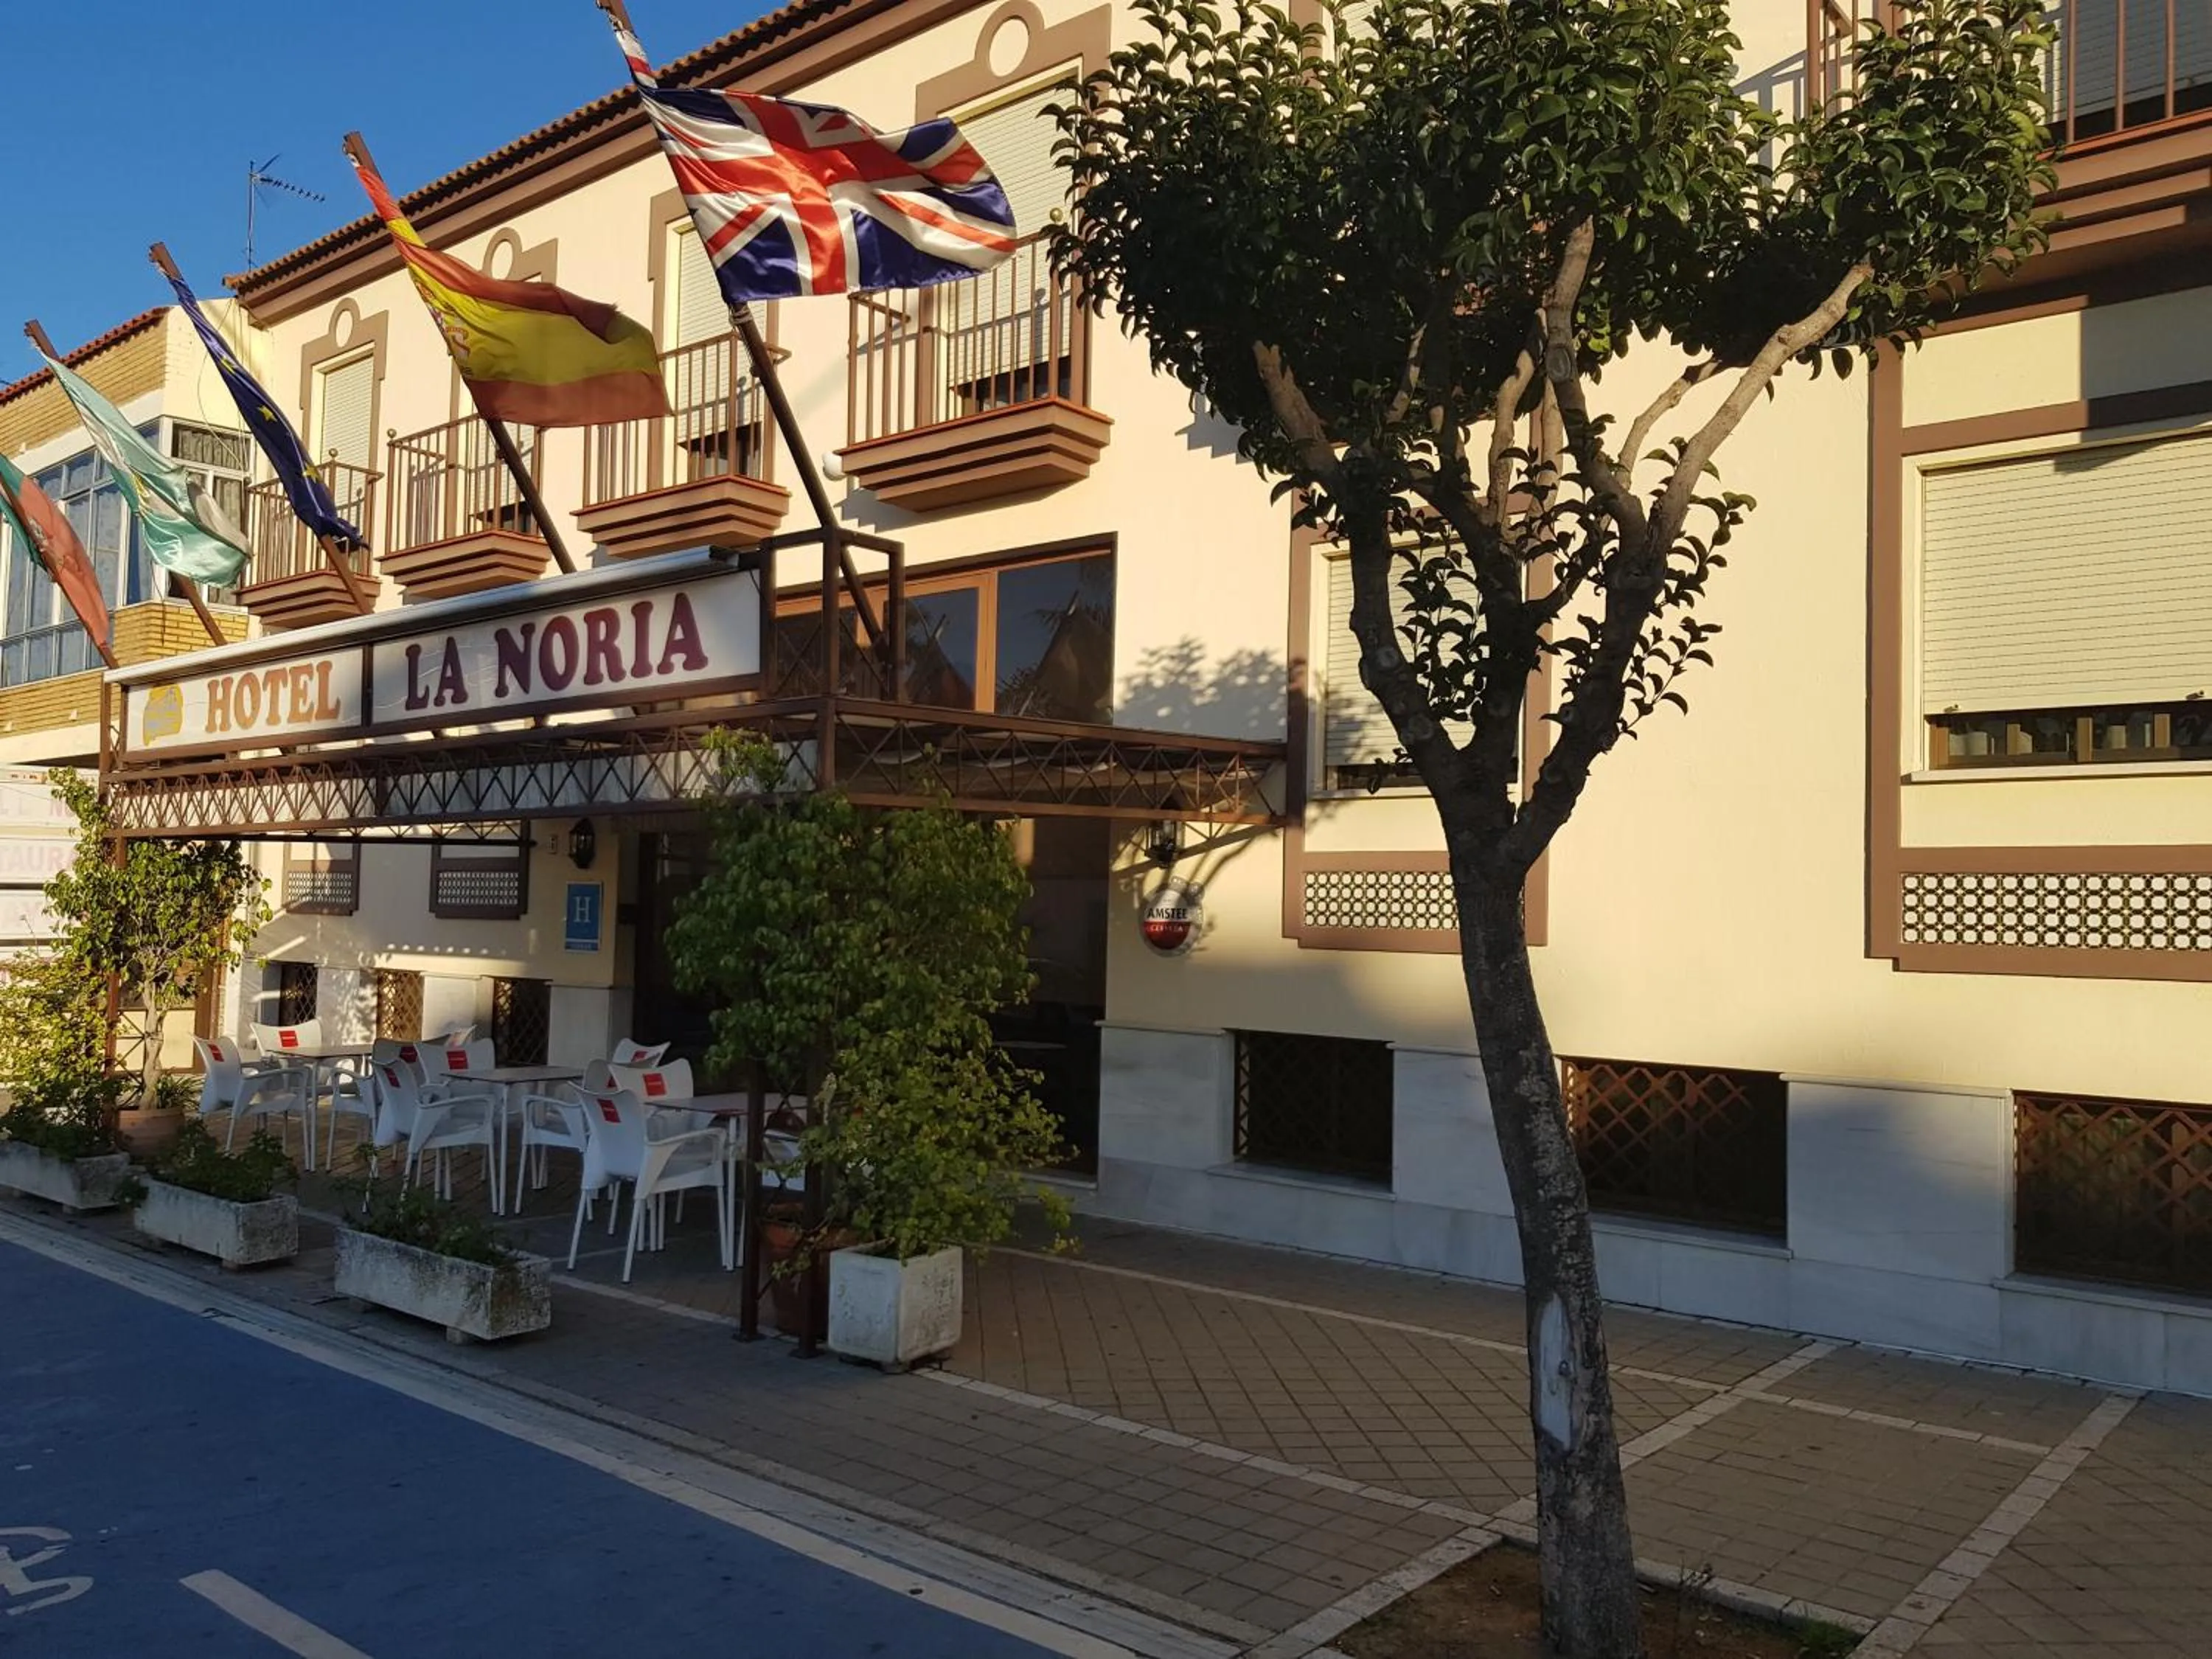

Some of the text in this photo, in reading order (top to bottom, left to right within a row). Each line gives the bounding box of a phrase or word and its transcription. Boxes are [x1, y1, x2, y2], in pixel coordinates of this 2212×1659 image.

[206, 592, 708, 733] HOTEL LA NORIA
[574, 896, 591, 922] H
